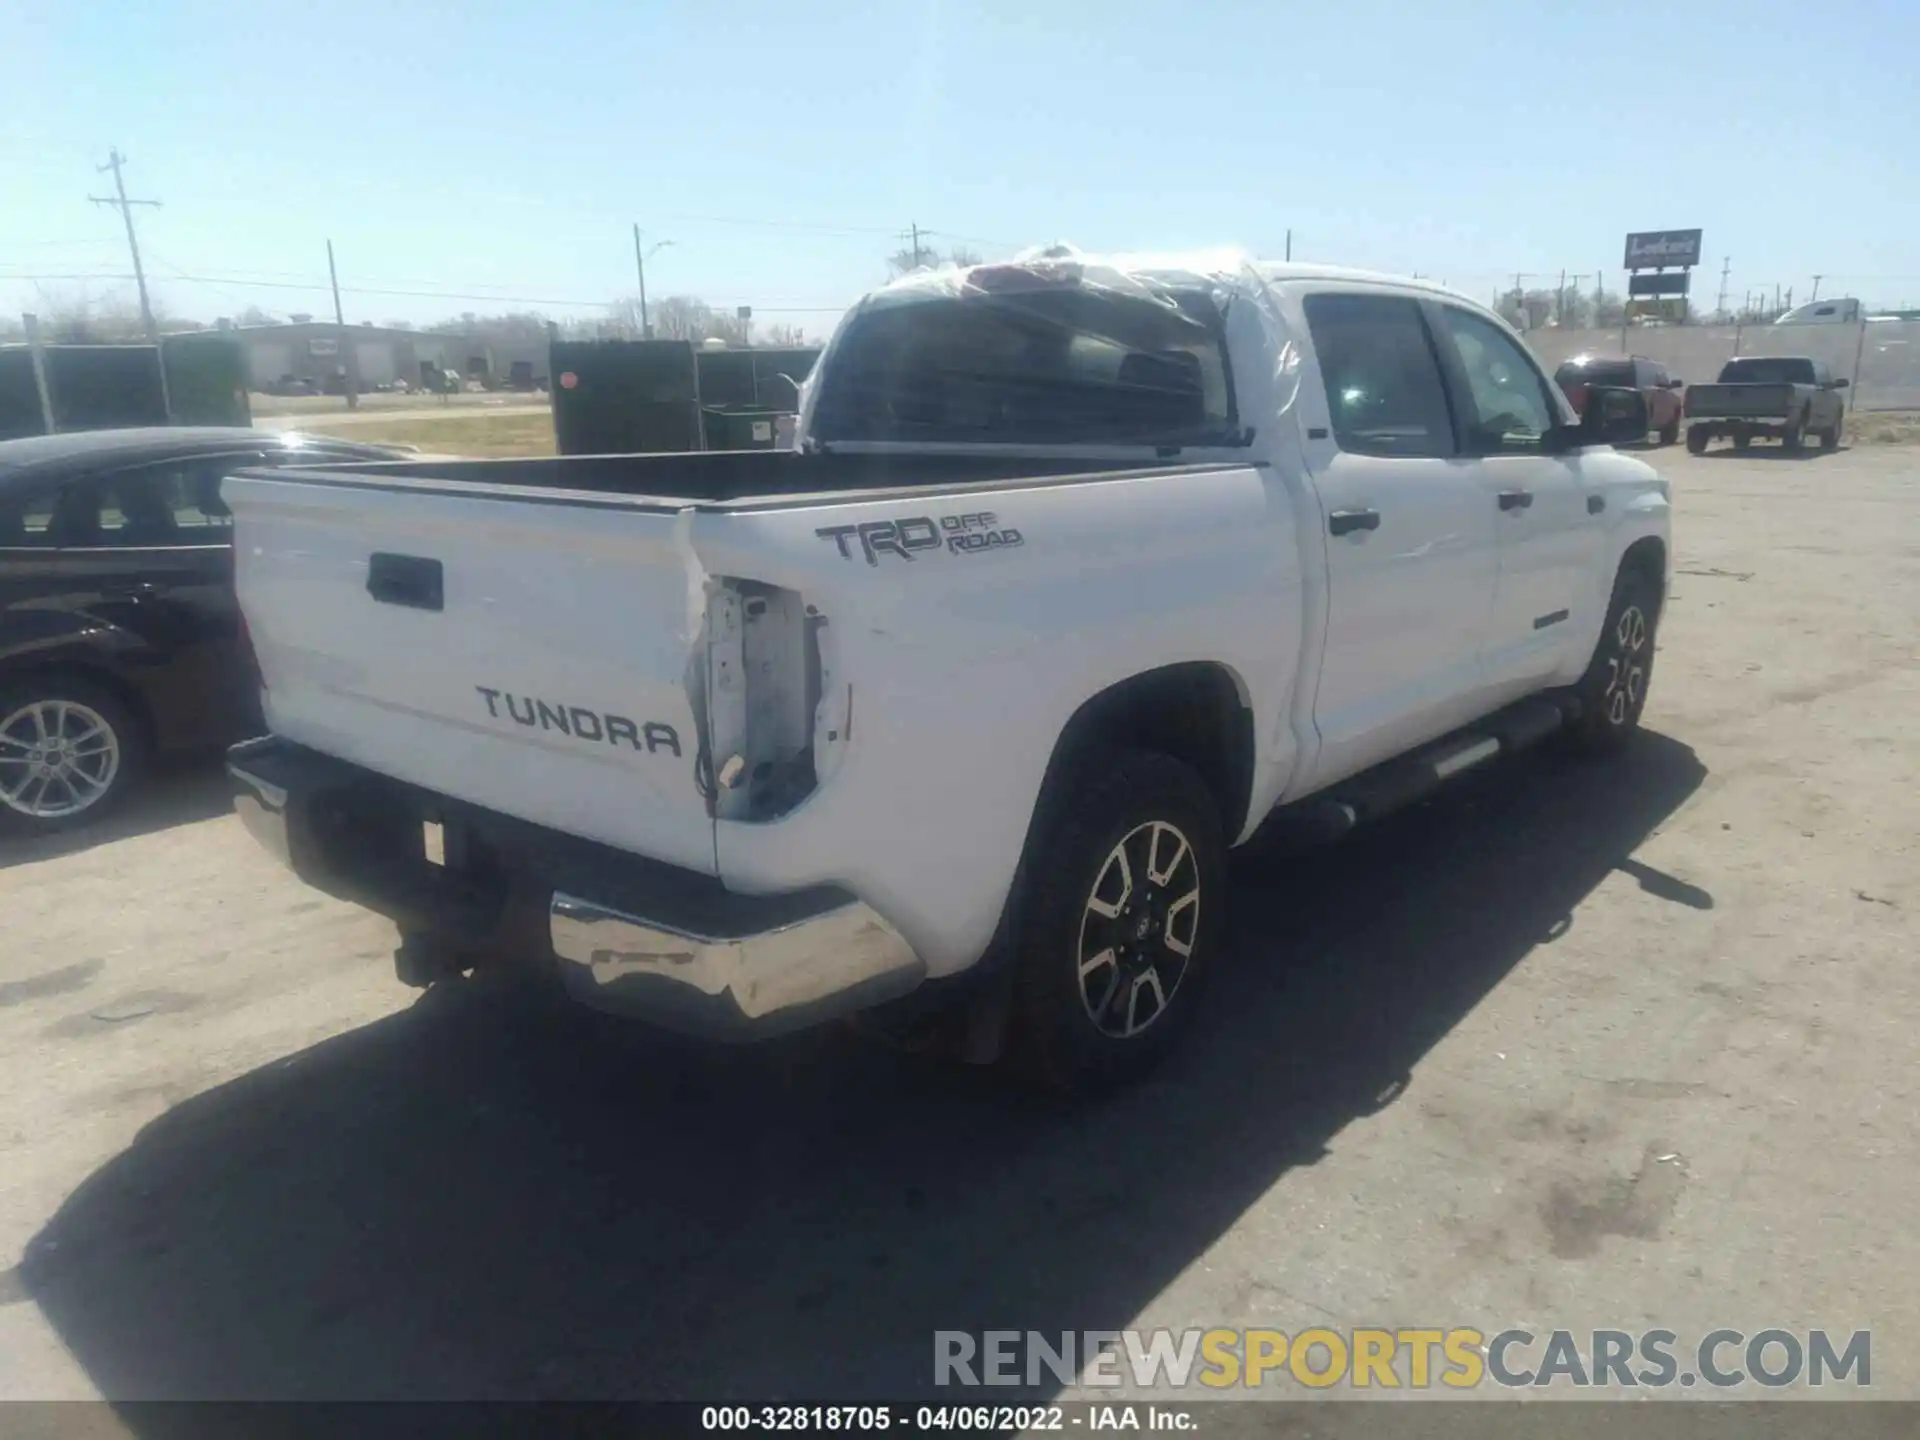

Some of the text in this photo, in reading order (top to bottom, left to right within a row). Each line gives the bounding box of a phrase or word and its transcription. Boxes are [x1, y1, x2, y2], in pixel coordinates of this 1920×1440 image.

[815, 512, 1025, 567] TRD OFF ROAD
[476, 685, 682, 758] TUNDRA
